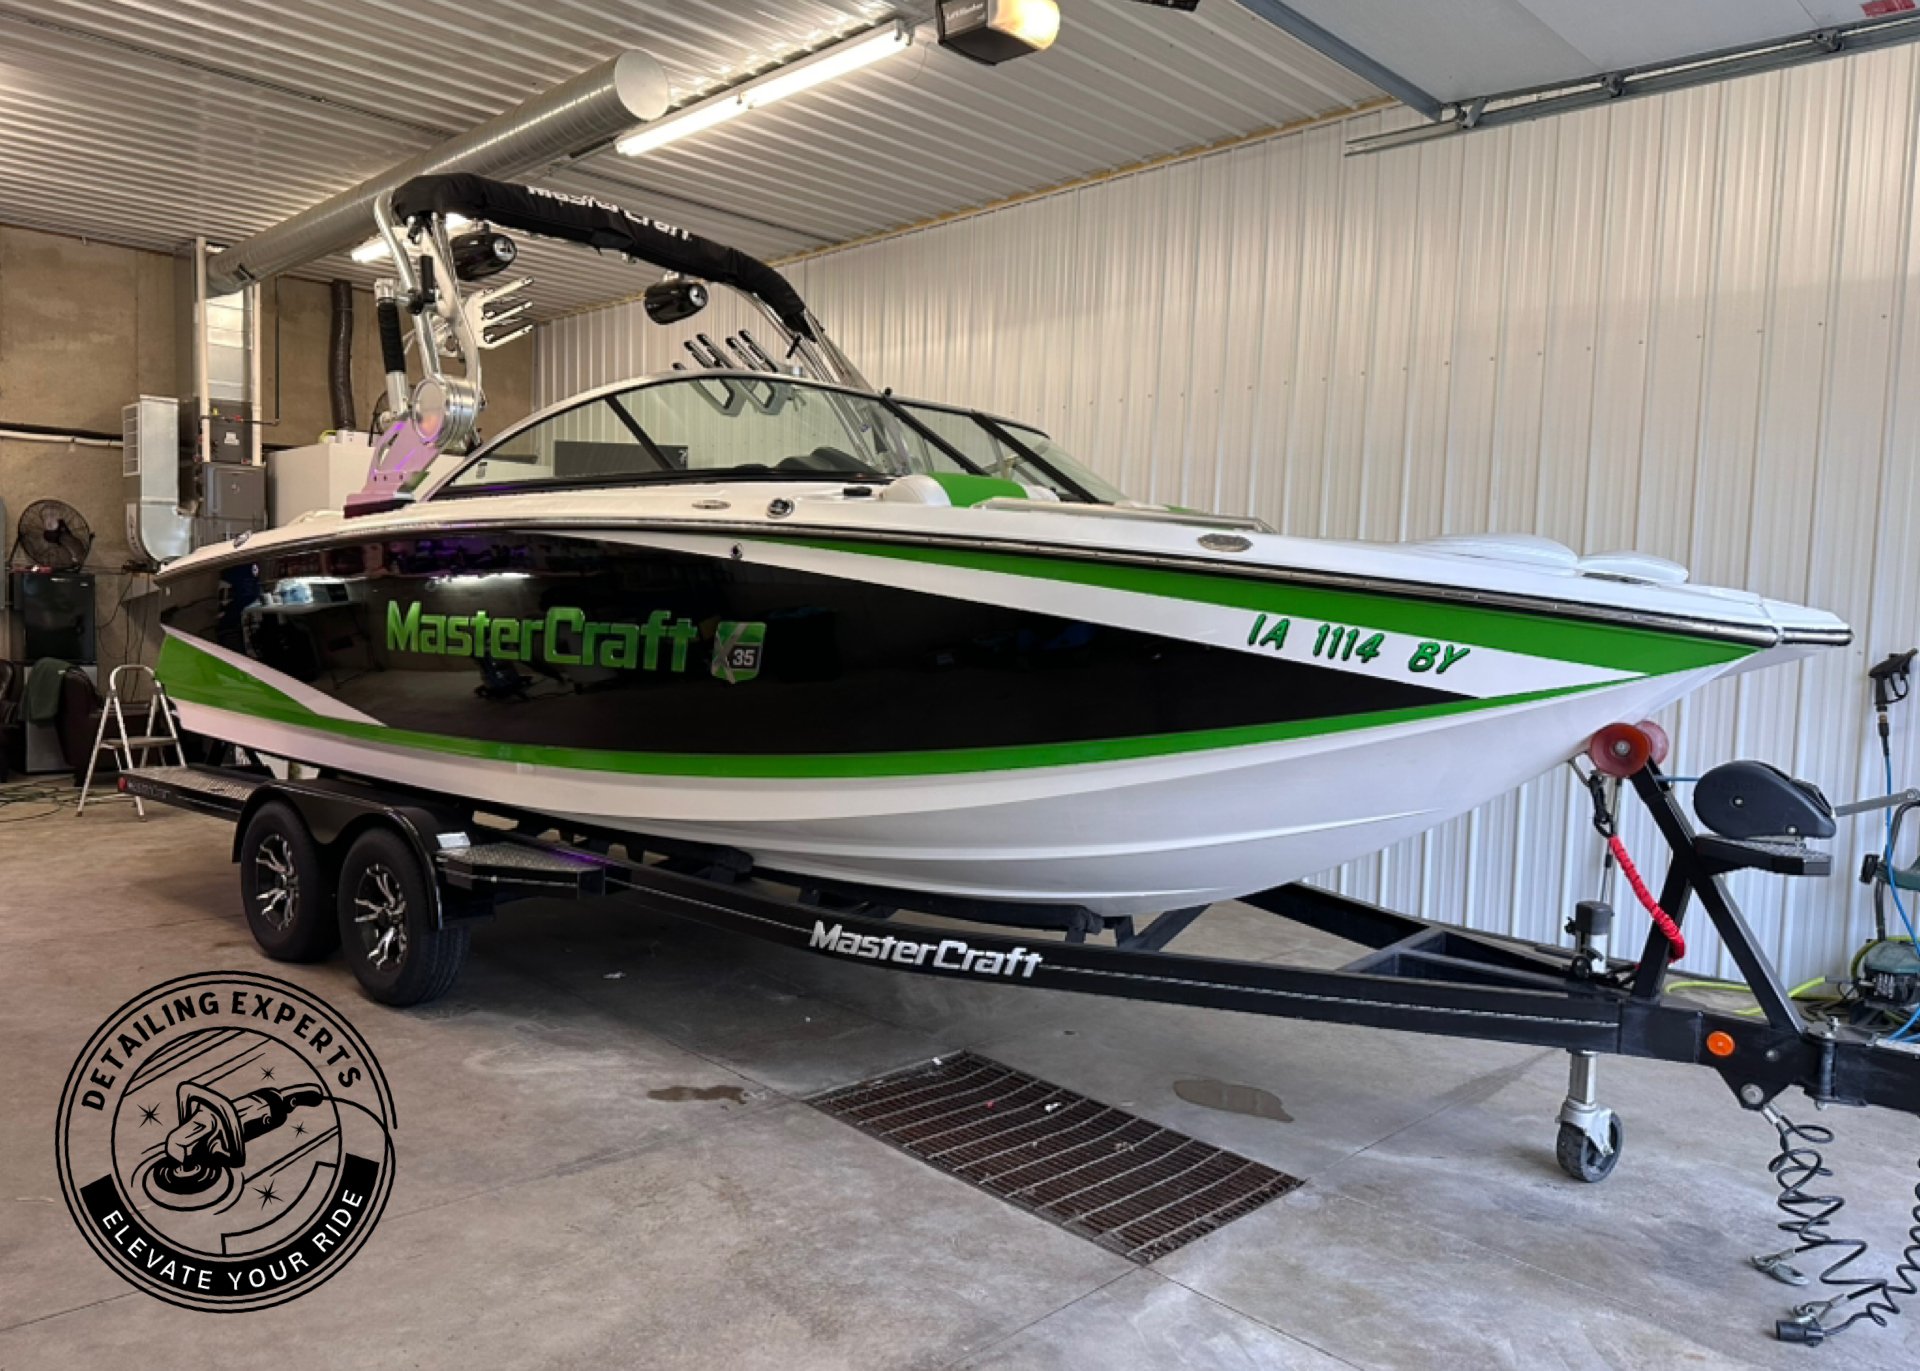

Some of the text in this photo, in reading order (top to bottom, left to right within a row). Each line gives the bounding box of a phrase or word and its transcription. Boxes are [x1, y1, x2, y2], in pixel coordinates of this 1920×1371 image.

[387, 600, 697, 672] MasterCraft
[732, 649, 755, 666] 35
[1247, 613, 1470, 674] IA 1114 BY
[809, 919, 1043, 978] MasterCraft
